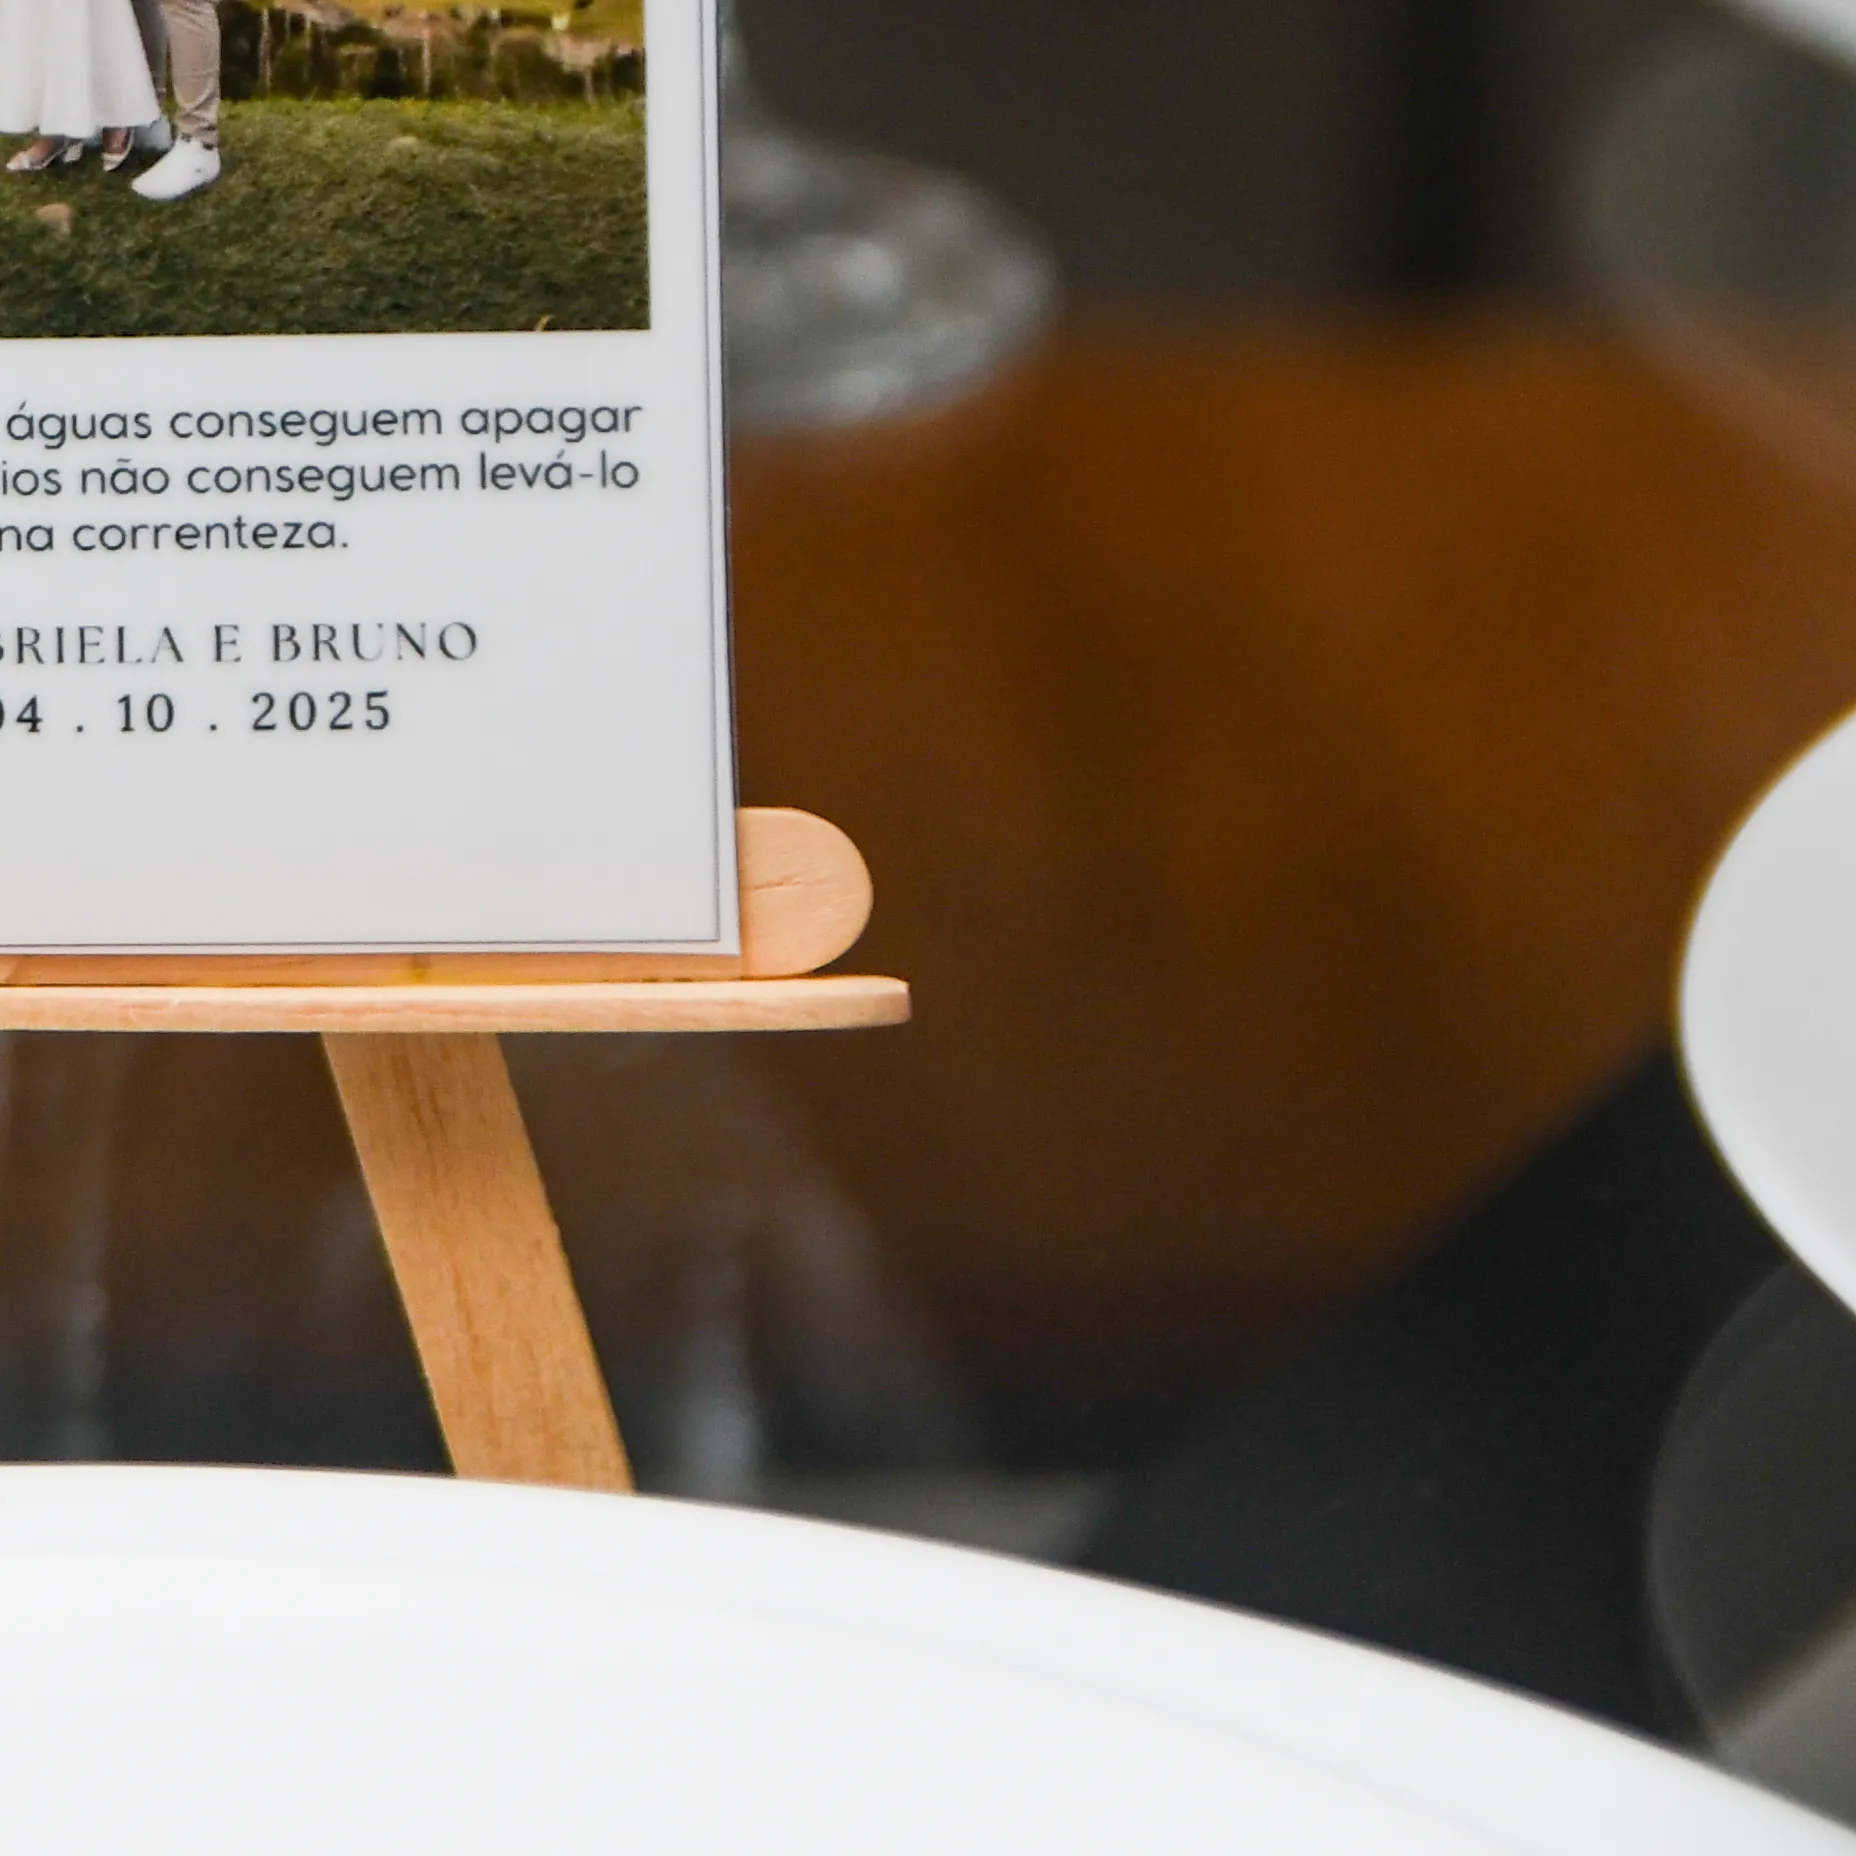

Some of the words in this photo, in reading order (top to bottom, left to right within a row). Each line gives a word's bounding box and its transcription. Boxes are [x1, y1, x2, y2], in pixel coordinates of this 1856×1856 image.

[5, 400, 153, 451] águas
[168, 408, 443, 448] conseguem
[459, 405, 643, 445] apagar
[80, 457, 171, 496] não
[186, 463, 461, 502] conseguem
[479, 449, 640, 491] levá-lo
[72, 514, 348, 552] correnteza.
[213, 624, 242, 663] E
[271, 621, 478, 662] BRUNO
